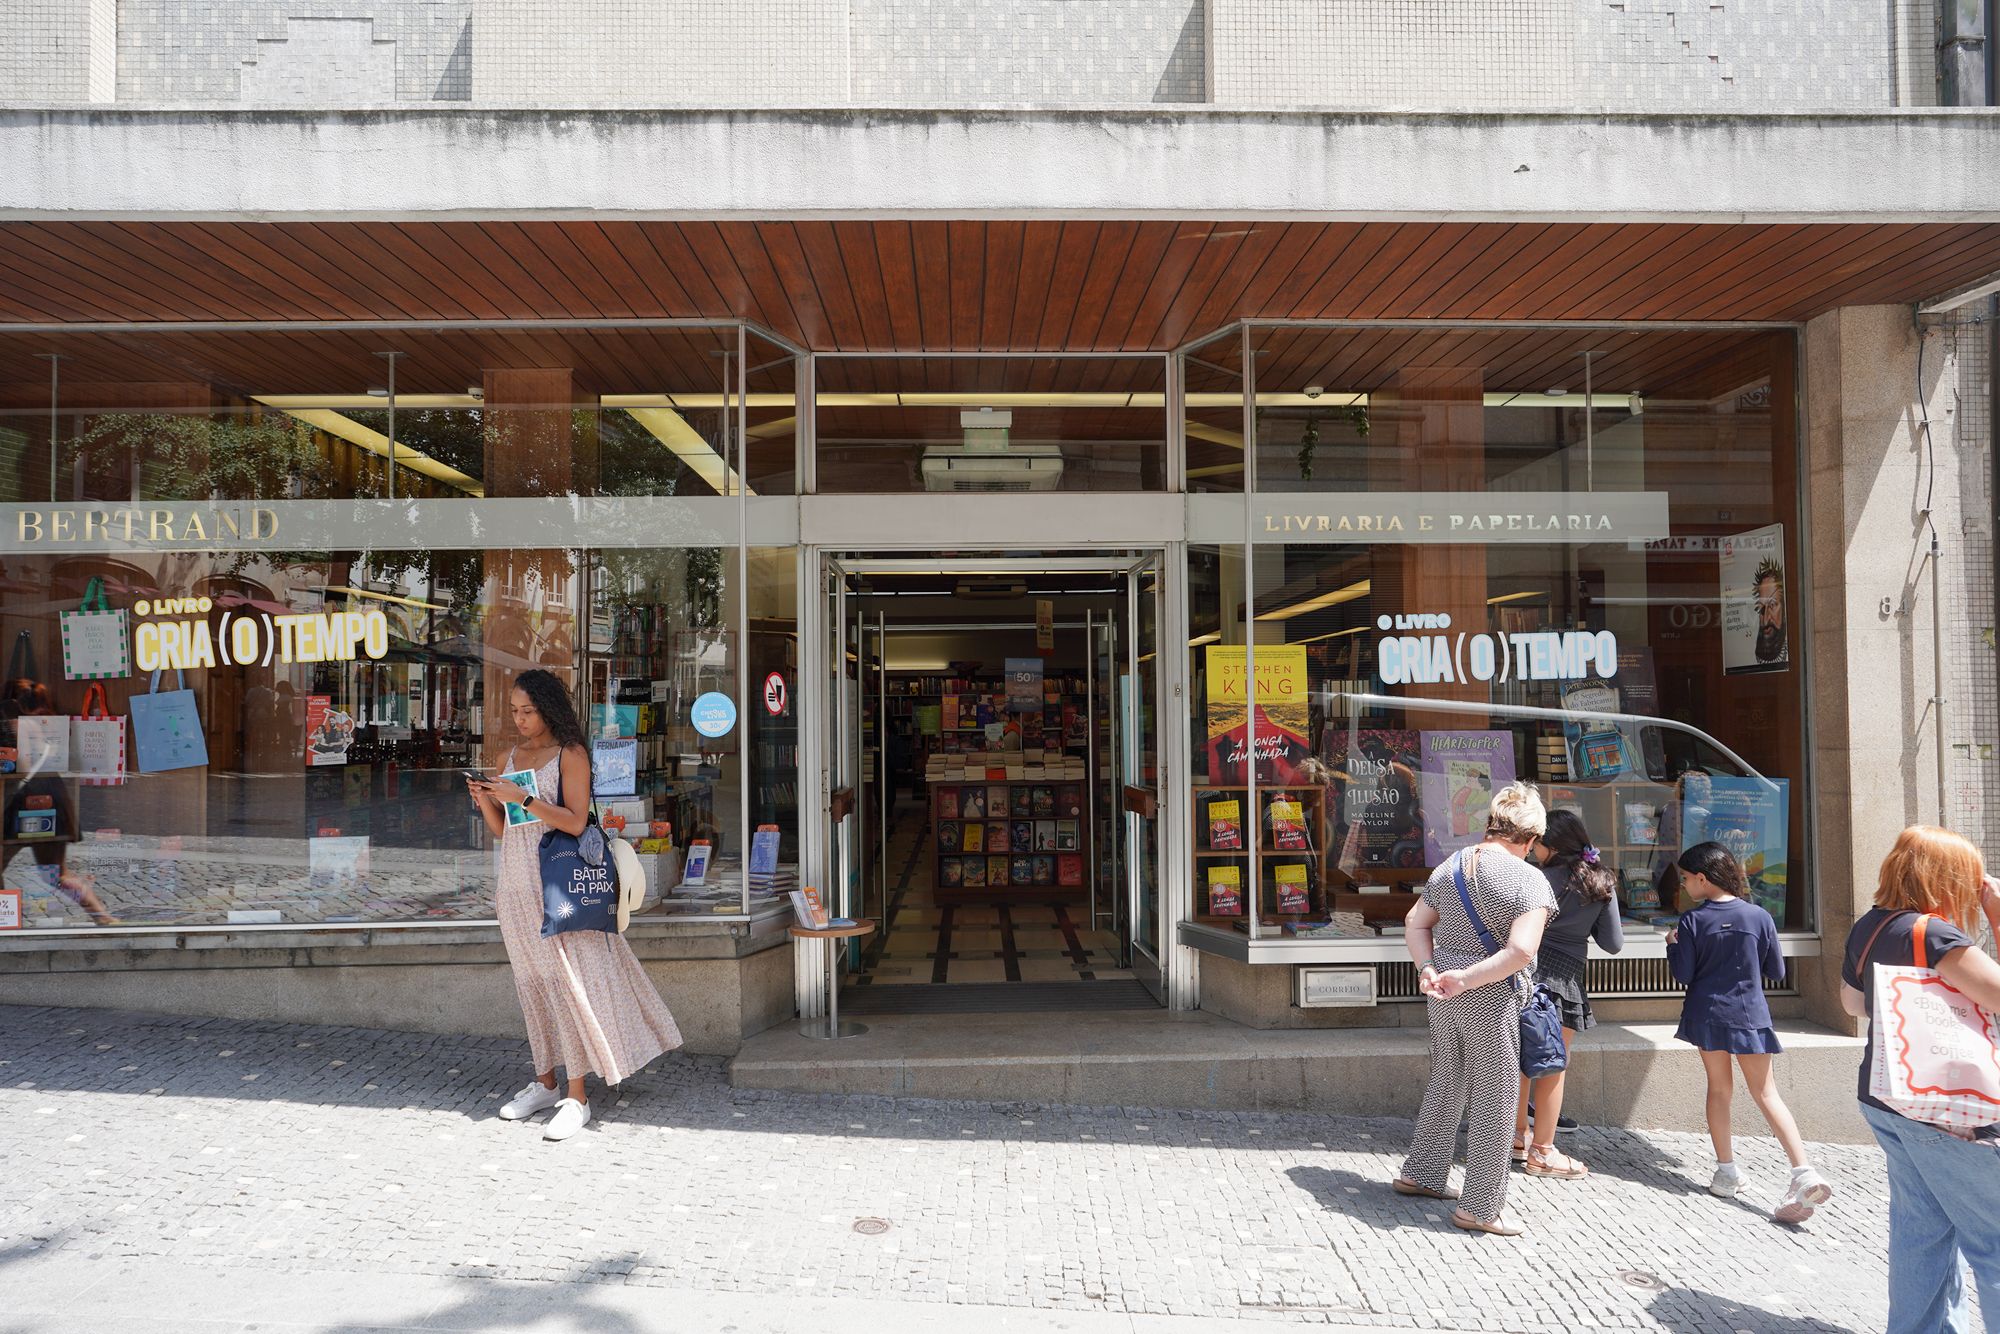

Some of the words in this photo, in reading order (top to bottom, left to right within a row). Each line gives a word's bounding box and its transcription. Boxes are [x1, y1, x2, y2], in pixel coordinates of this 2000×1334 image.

[16, 508, 279, 542] BERTRAND
[1264, 514, 1404, 532] LIVRARIA
[1418, 514, 1435, 531] E
[1449, 513, 1614, 531] PAPELARIA
[134, 600, 150, 616] O
[153, 597, 213, 615] LIVRO
[1377, 614, 1392, 630] O
[1395, 613, 1452, 629] LIVRO
[1223, 665, 1292, 675] STEPHEN
[1234, 738, 1243, 749] A
[1254, 733, 1283, 747] ONGA
[1430, 735, 1502, 752] HEARTSTOPPER
[1227, 746, 1289, 763] CAMNHADA
[1368, 751, 1374, 759] A
[1347, 759, 1396, 777] DEUSA
[1368, 778, 1378, 786] DA
[1347, 788, 1400, 806] ILUSÃO
[573, 866, 607, 881] BÂTIR
[568, 881, 586, 894] LA
[588, 881, 614, 894] PAIX
[1318, 985, 1360, 994] CORREIO
[1914, 997, 1946, 1014] Buy
[1950, 1005, 1968, 1018] me
[1925, 1013, 1966, 1031] books
[1929, 1044, 1975, 1060] coffee
